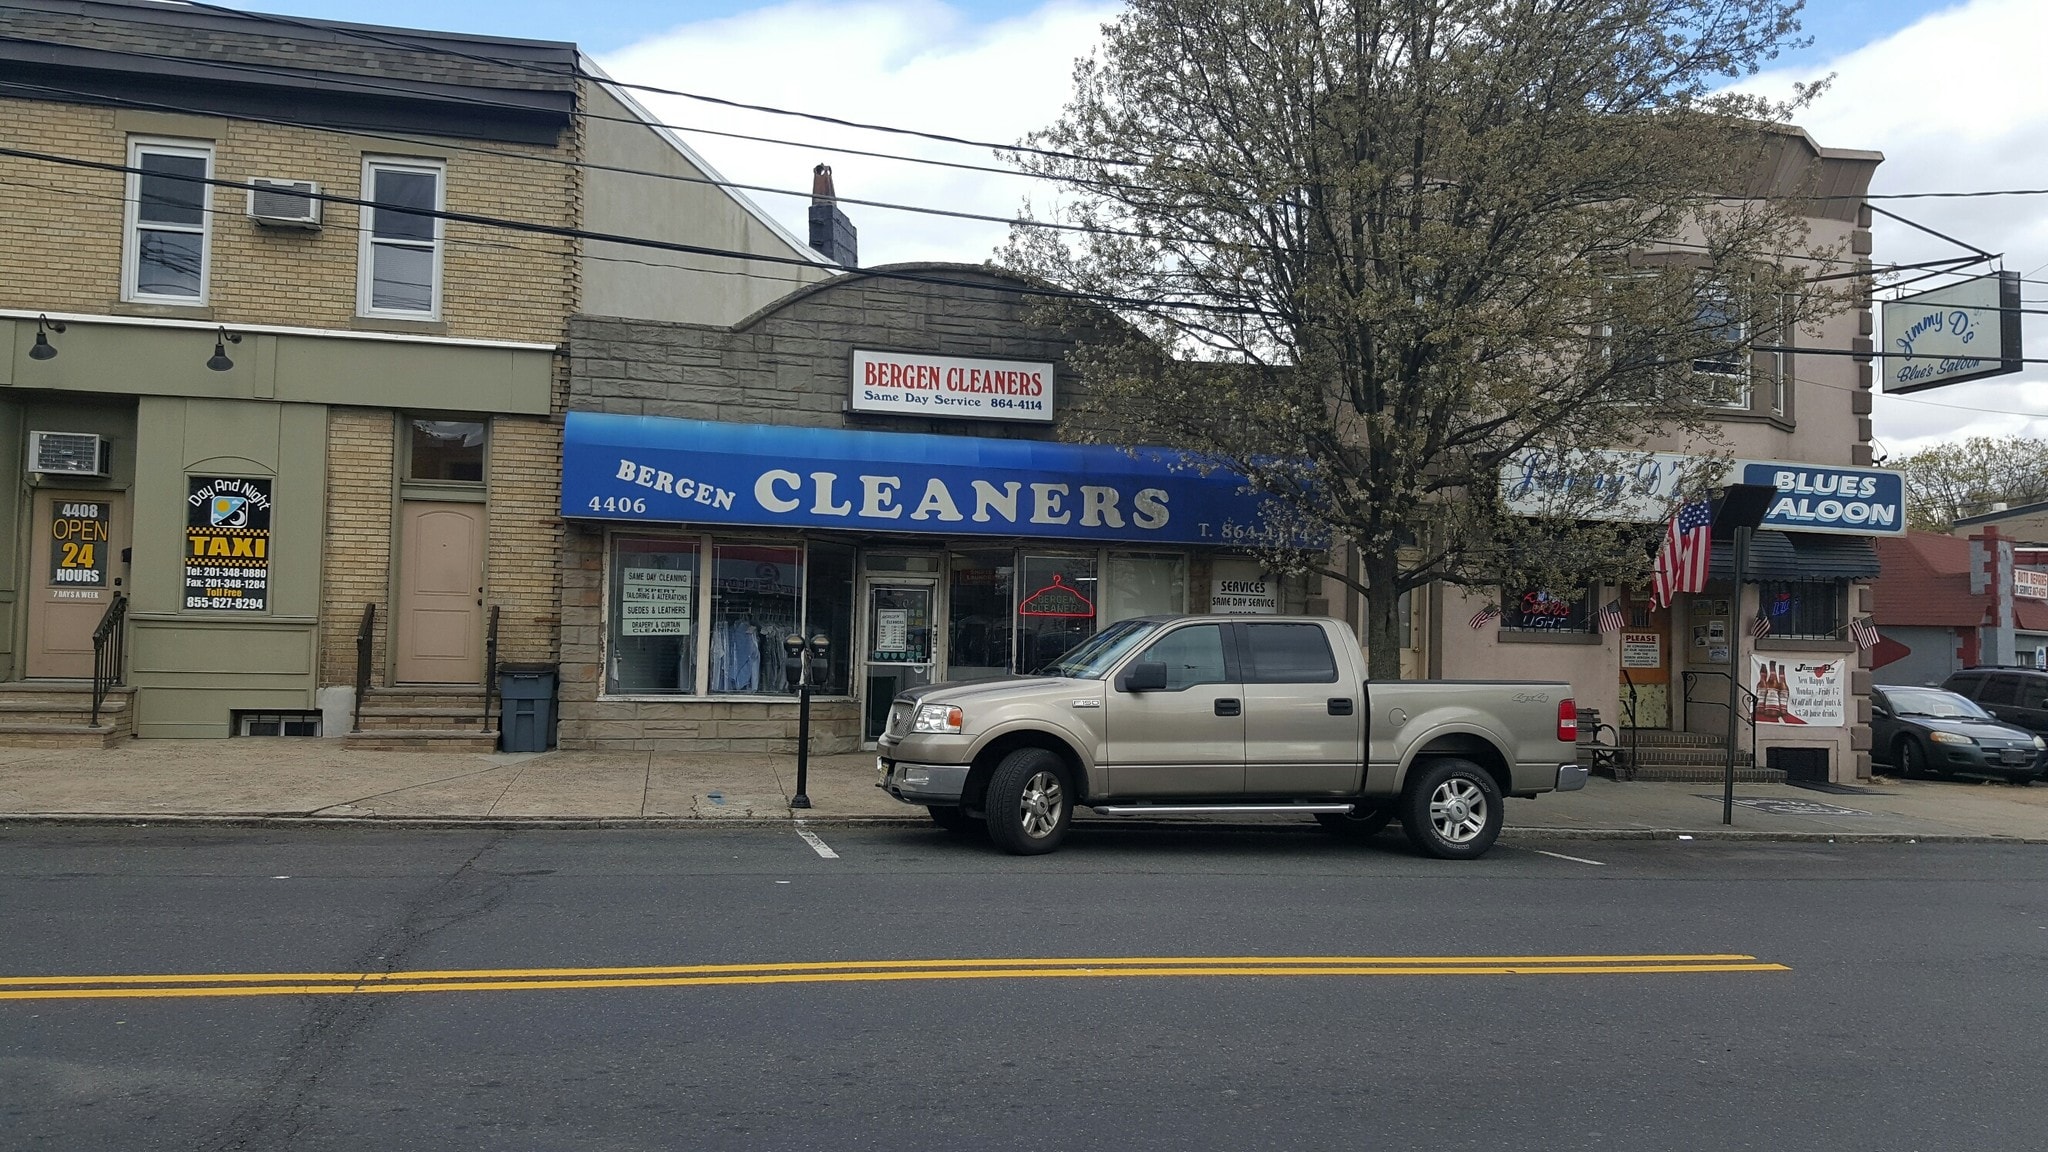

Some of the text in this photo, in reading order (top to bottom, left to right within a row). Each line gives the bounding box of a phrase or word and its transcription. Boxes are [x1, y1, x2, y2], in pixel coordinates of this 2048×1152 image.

[1896, 311, 1943, 361] Jimmy
[865, 362, 1042, 396] BERGEN CLEANERS
[1897, 358, 1980, 382] Blue's Saloon
[864, 390, 1042, 410] Same Day Service 864-4114
[616, 459, 736, 511] BERGEN
[1773, 471, 1877, 498] BLUES
[188, 479, 271, 511] Day And Night
[754, 469, 1170, 529] CLEANERS
[62, 504, 98, 518] 4408
[588, 496, 646, 514] 4406
[1766, 498, 1895, 526] ALOON
[53, 518, 108, 541] OPEN
[1198, 523, 1309, 542] T. 864-414
[62, 542, 94, 568] 24
[189, 536, 266, 558] TAXI
[56, 568, 100, 582] HOURS
[186, 566, 266, 578] Tel: 201-348-0880
[628, 572, 644, 580] SAME
[659, 574, 687, 582] CLEANING
[186, 578, 266, 588] Fax: 201-348-1284
[206, 588, 222, 596] Toll
[1221, 581, 1266, 594] SERVICES
[54, 590, 58, 598] 7
[187, 596, 264, 609] 855-627-8294
[1212, 597, 1275, 608] SAME DAY SERVICE
[628, 606, 686, 614] SUEDES & LEATHERS
[1521, 592, 1570, 616] Coors
[1523, 616, 1567, 628] LIGHT
